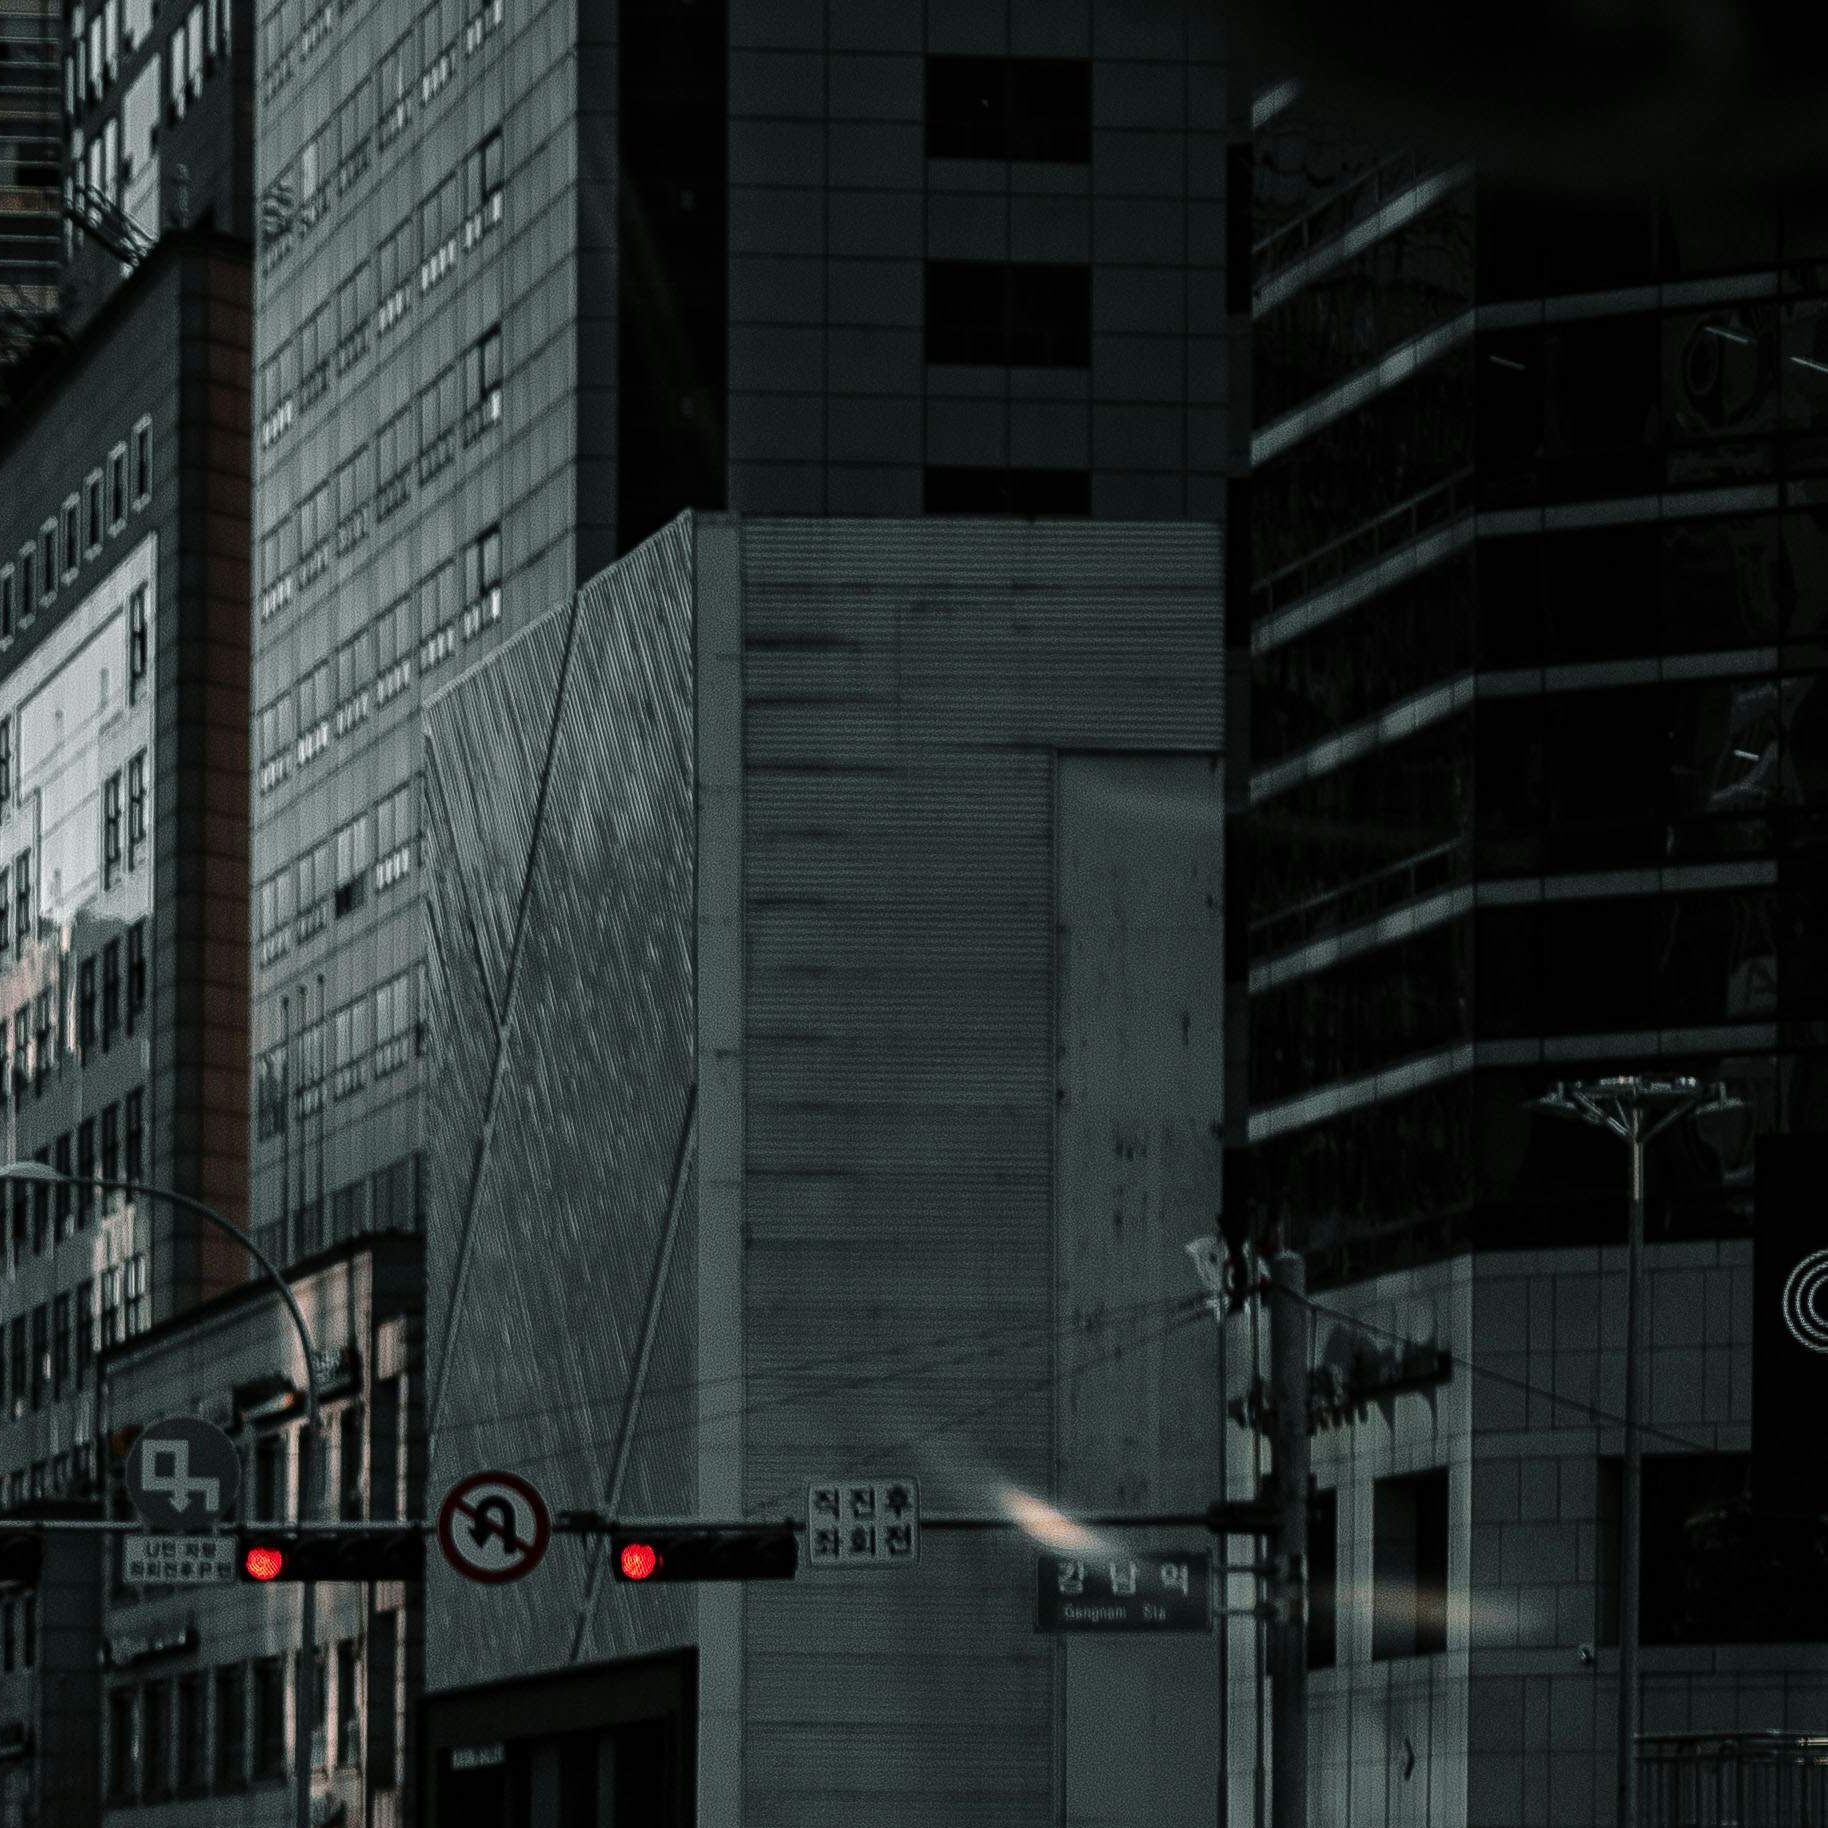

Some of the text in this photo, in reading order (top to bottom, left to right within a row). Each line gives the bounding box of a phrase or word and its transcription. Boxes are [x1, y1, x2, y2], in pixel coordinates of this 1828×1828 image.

[814, 1486, 909, 1520] 직진후
[814, 1526, 912, 1558] 좌회전
[1057, 1560, 1190, 1597] 강남역
